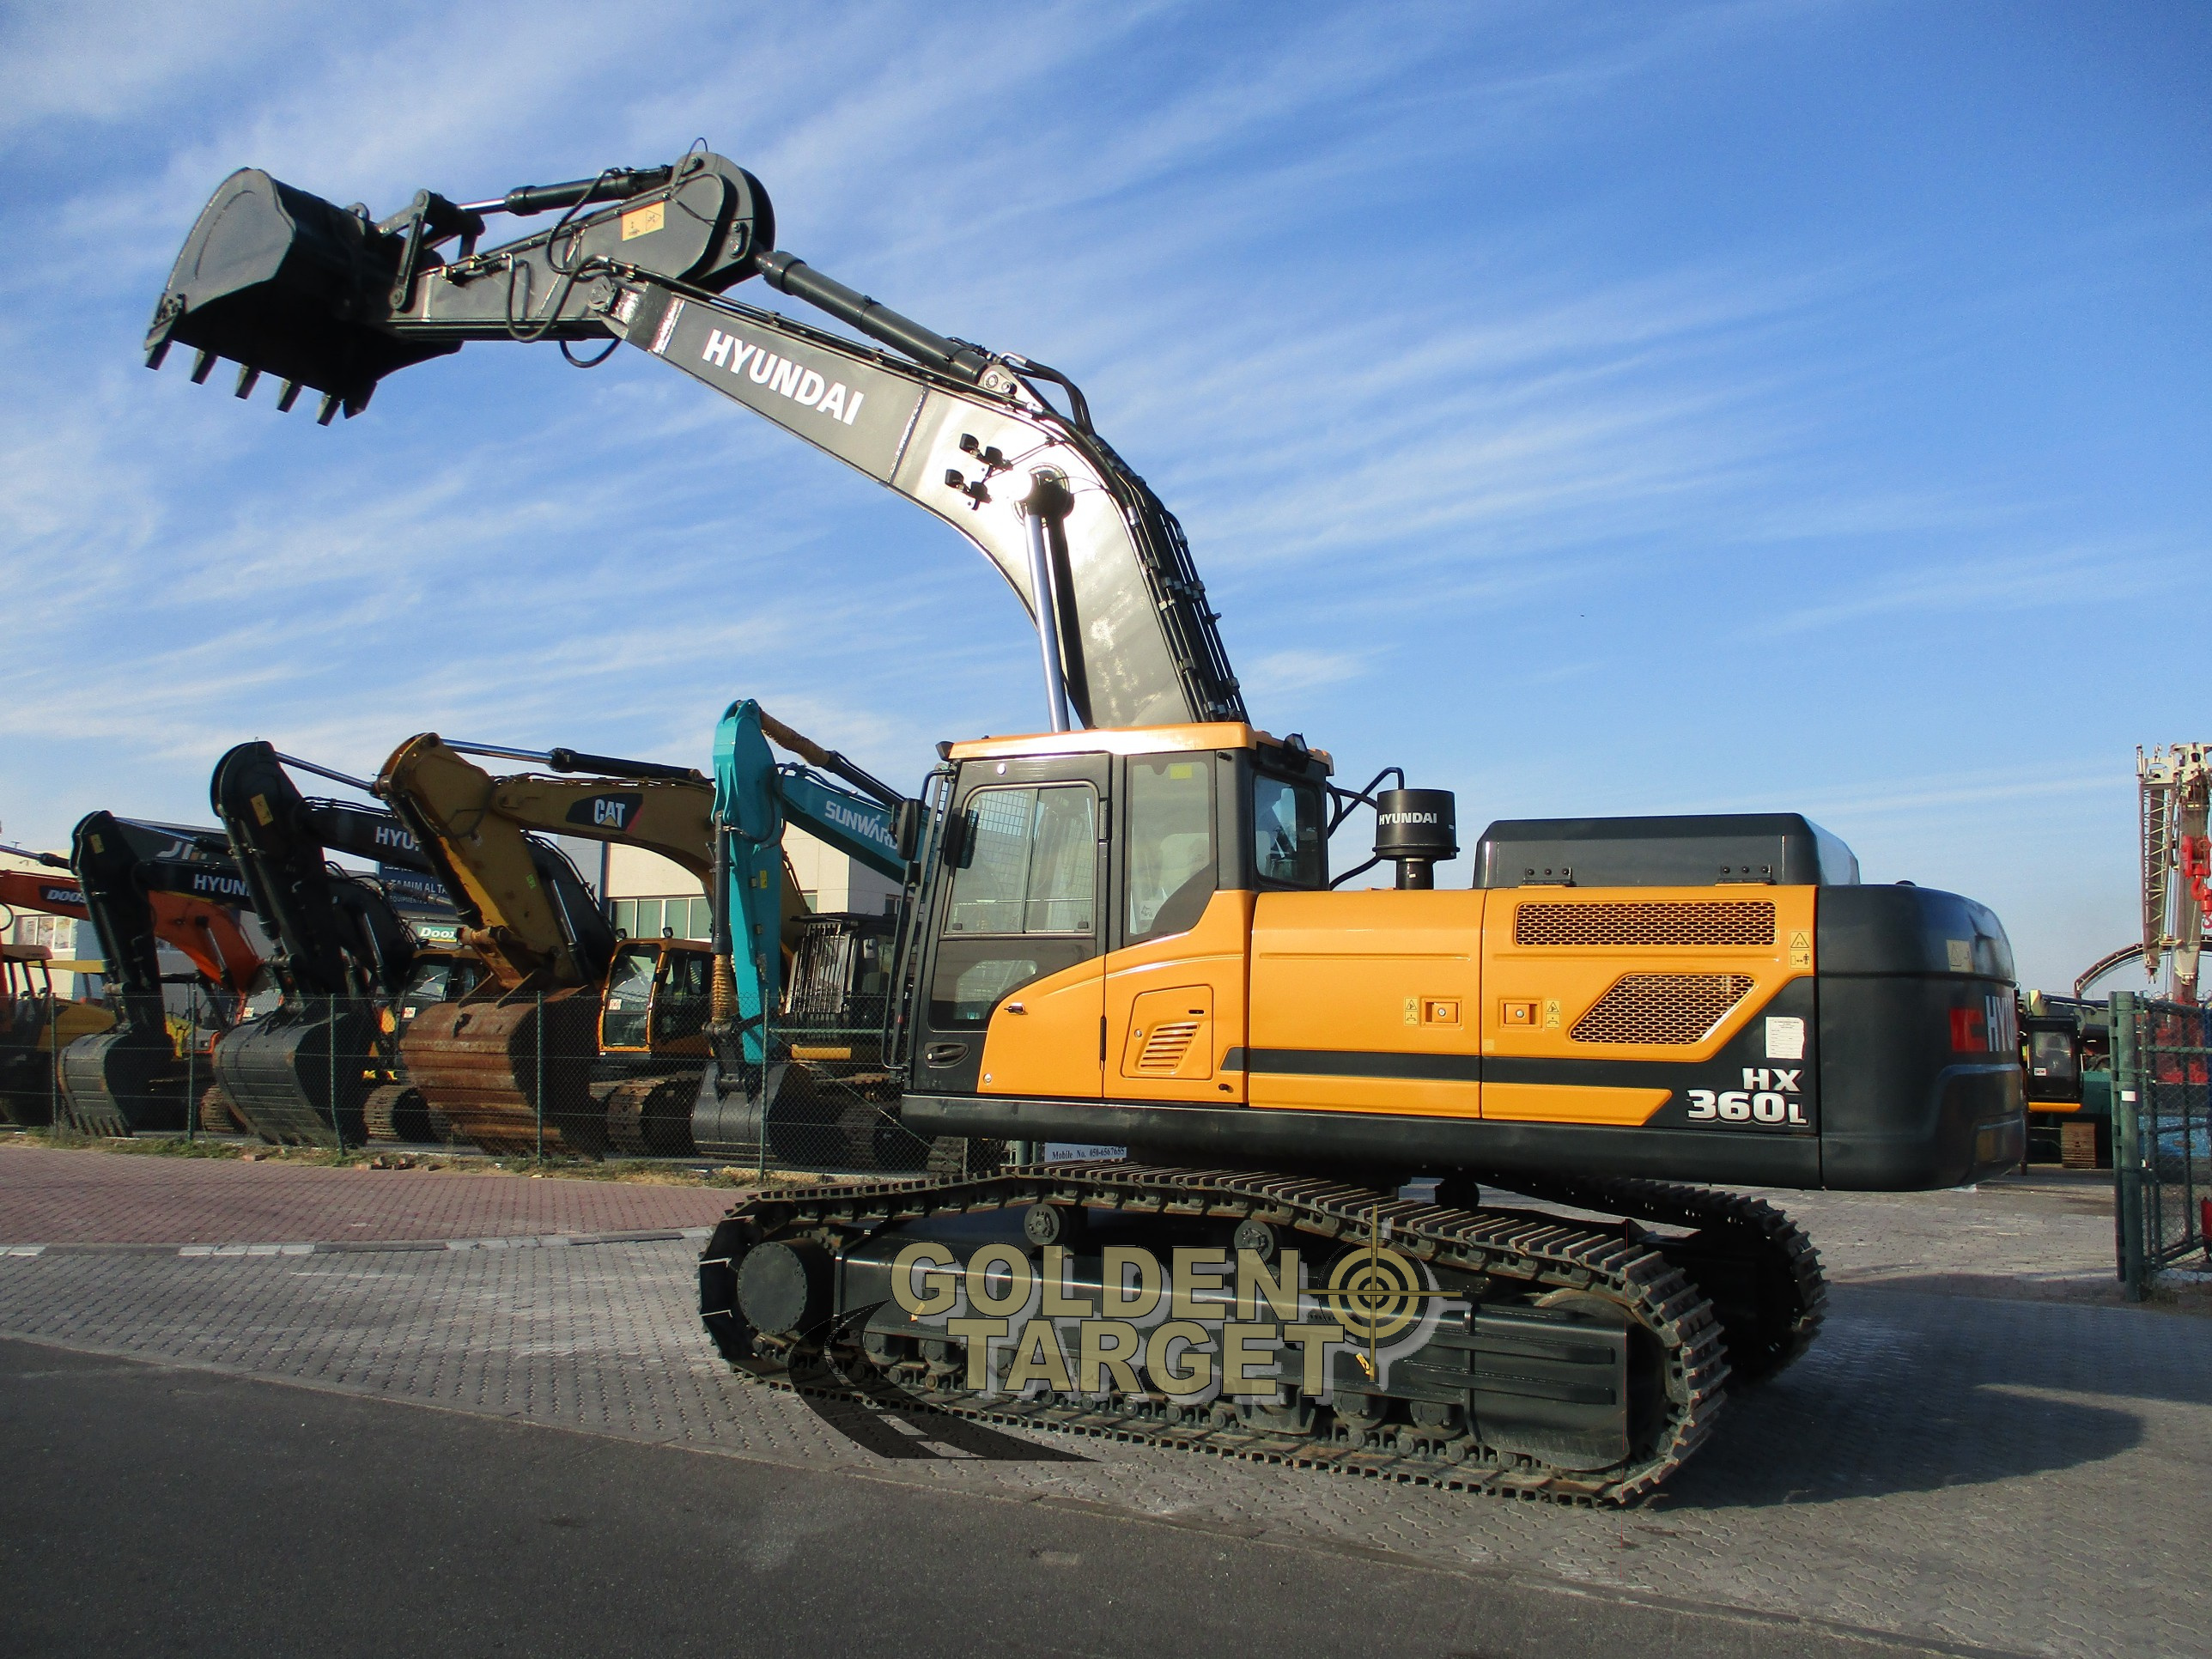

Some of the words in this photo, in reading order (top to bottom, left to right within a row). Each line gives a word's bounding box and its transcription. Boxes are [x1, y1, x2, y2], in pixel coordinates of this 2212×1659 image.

[702, 329, 865, 426] HYUNDAI
[594, 799, 626, 828] CAT
[1379, 812, 1437, 826] HYUNDAI
[375, 826, 420, 852] HYU
[1742, 1067, 1803, 1093] HX
[1686, 1090, 1808, 1125] 360L
[1052, 1150, 1073, 1160] Mobile
